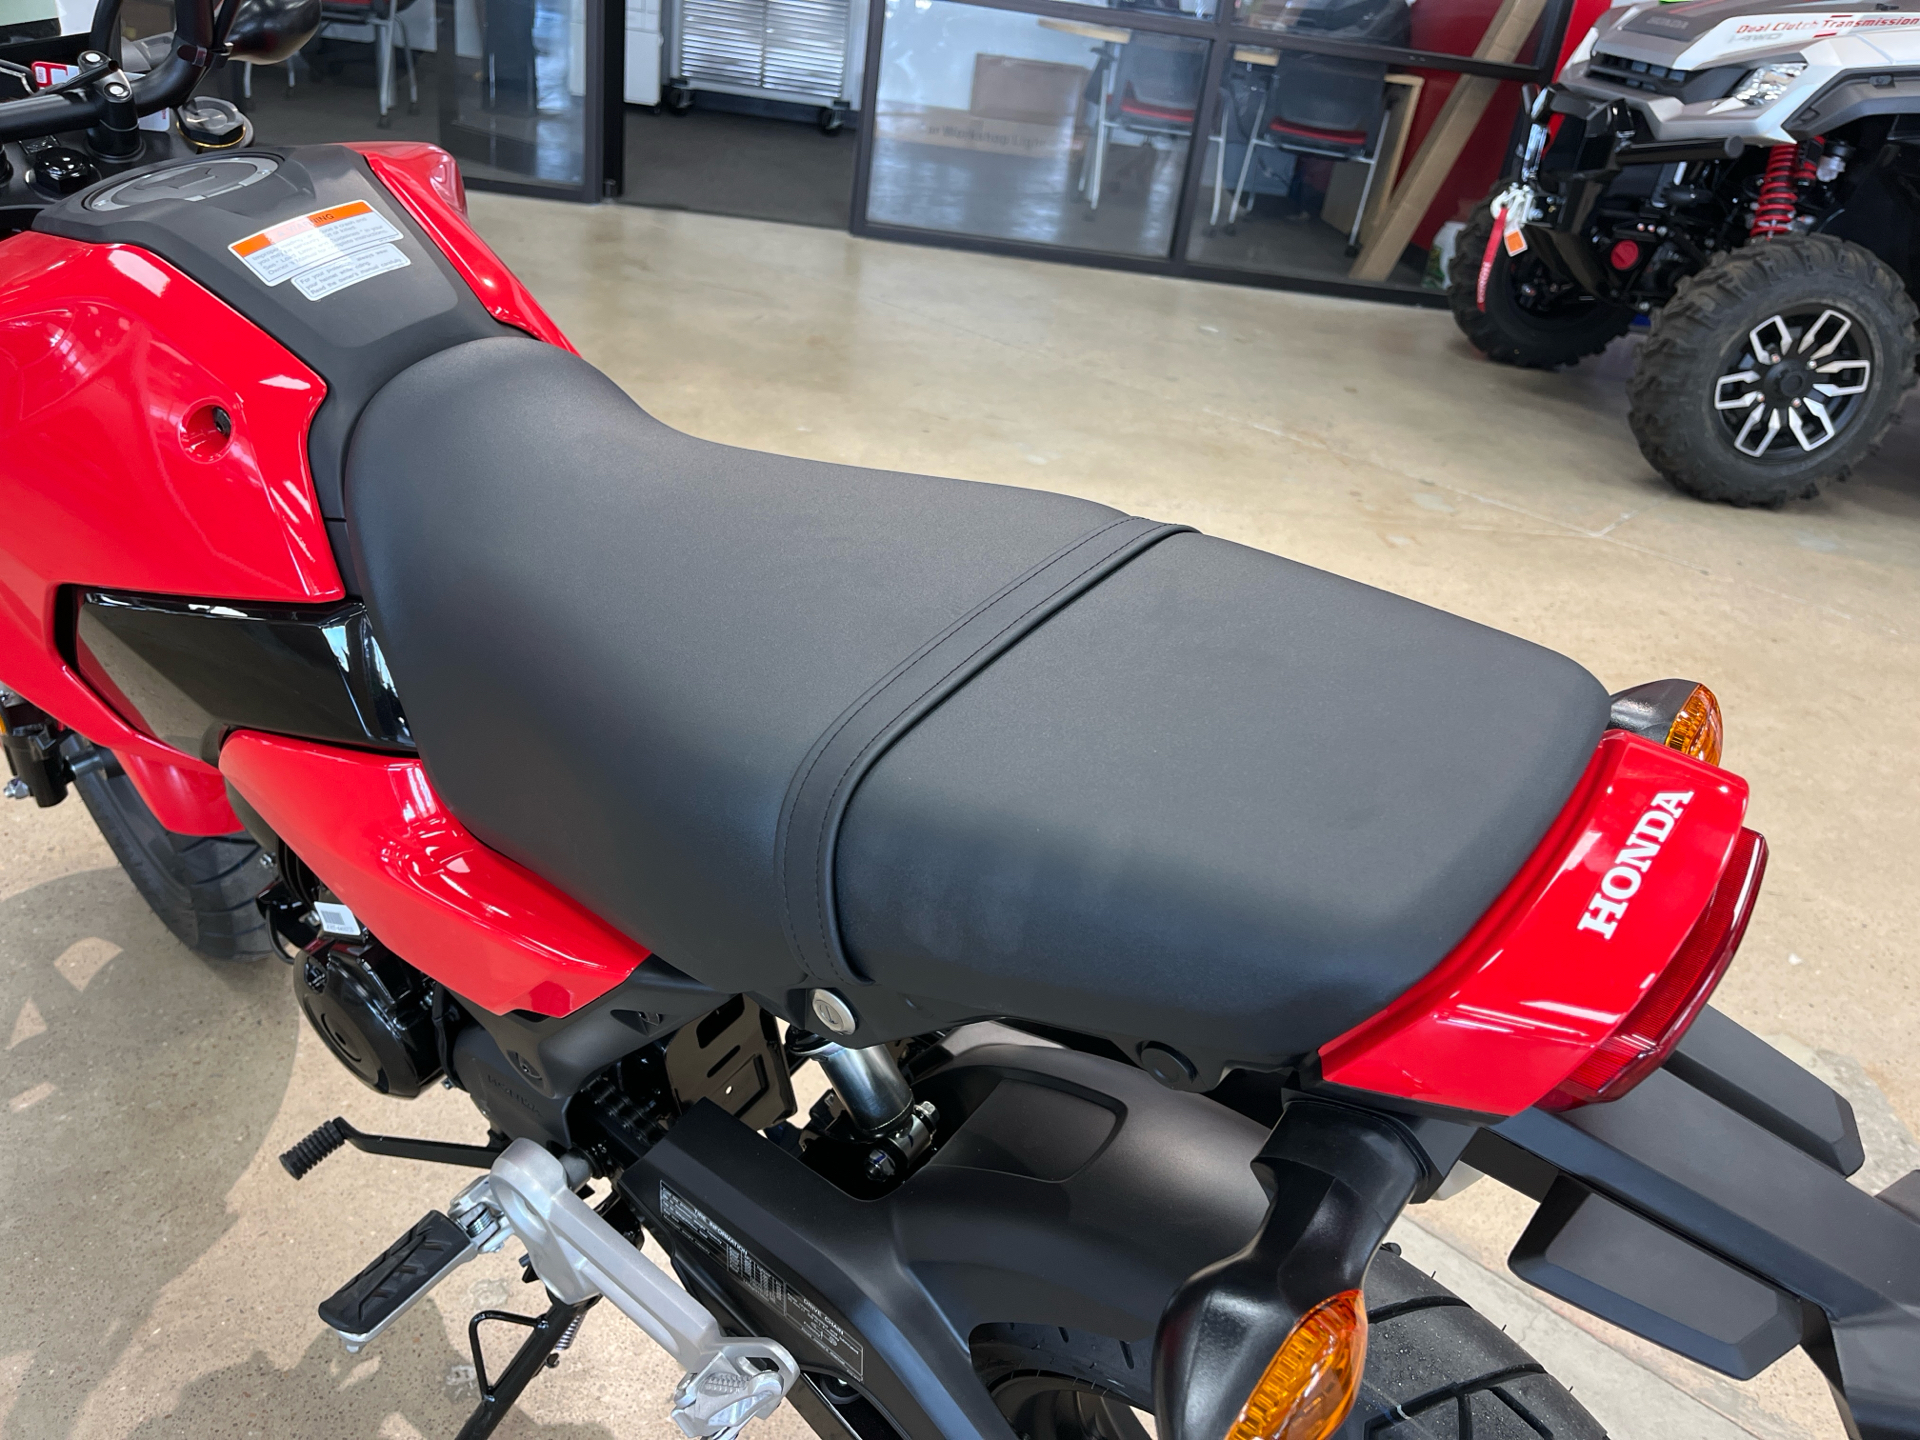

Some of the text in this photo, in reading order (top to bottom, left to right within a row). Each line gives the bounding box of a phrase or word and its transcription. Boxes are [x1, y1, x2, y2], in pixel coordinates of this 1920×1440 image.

[1823, 16, 1920, 29] Transmission
[287, 213, 335, 234] WARNING
[1577, 790, 1695, 941] HONDA
